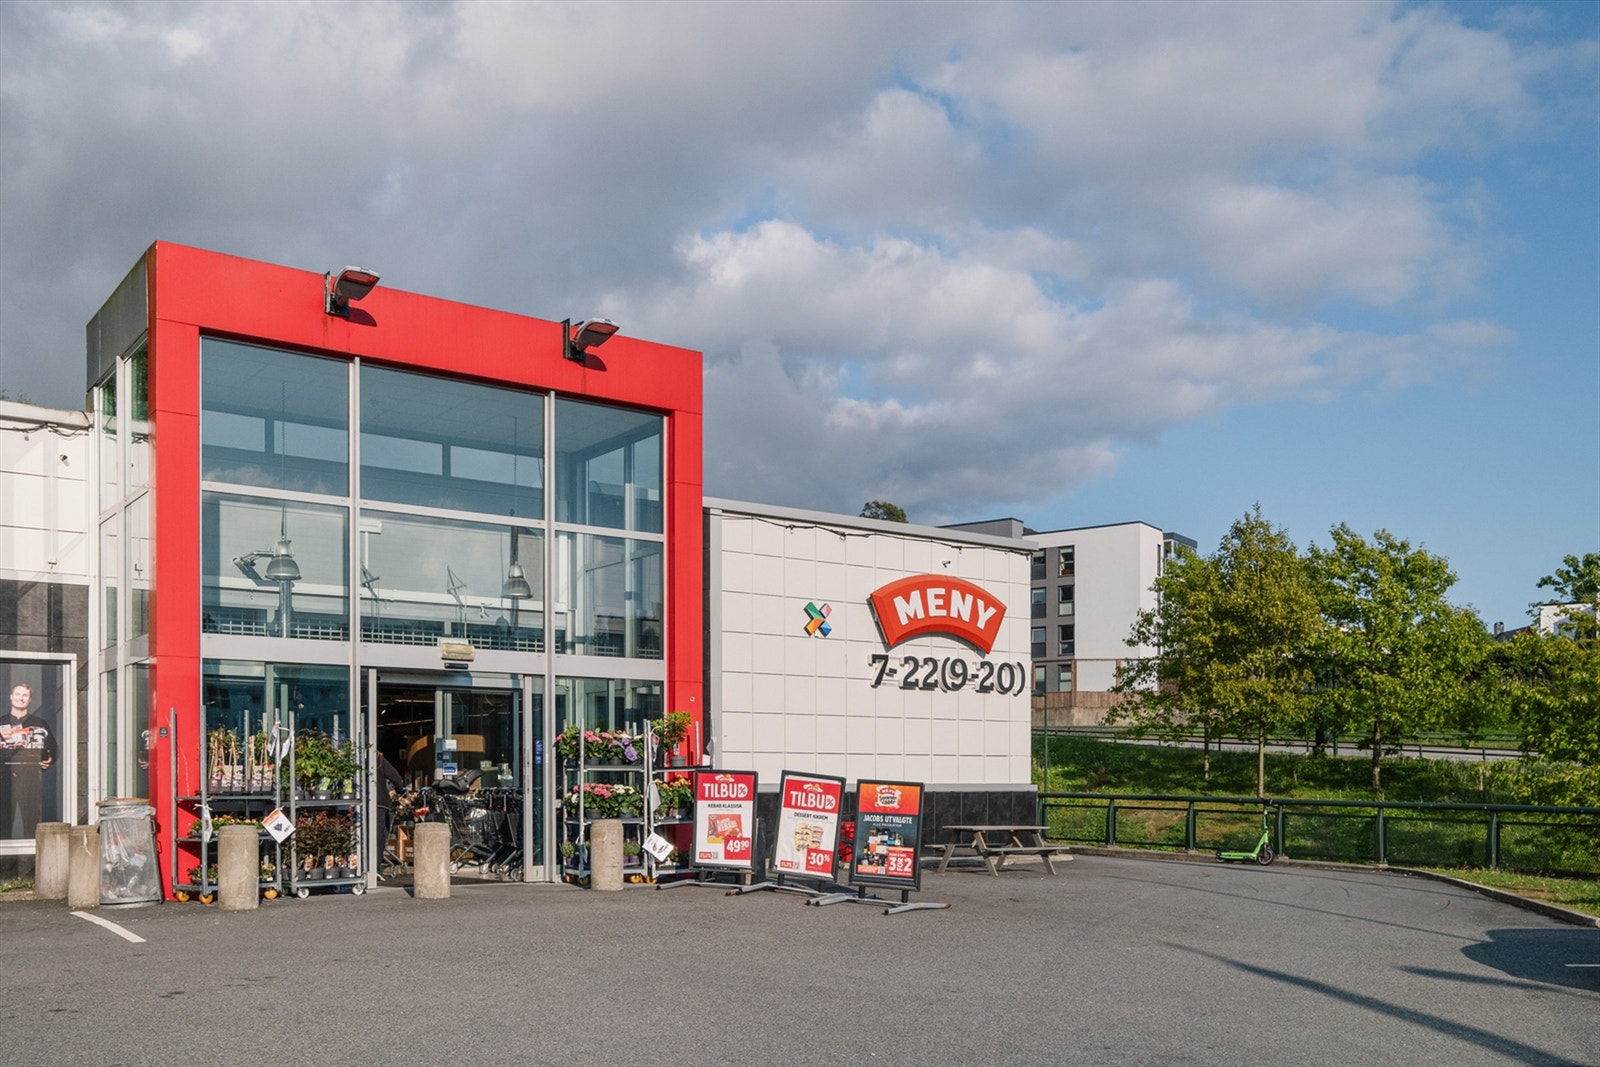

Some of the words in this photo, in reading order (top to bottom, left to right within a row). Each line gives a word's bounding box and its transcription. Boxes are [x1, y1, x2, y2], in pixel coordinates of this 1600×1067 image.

[893, 588, 997, 630] MENY
[703, 783, 748, 798] TILBUD
[790, 790, 836, 810] TILBUD
[863, 814, 884, 823] JACOBS
[884, 815, 913, 825] UTVALGTE
